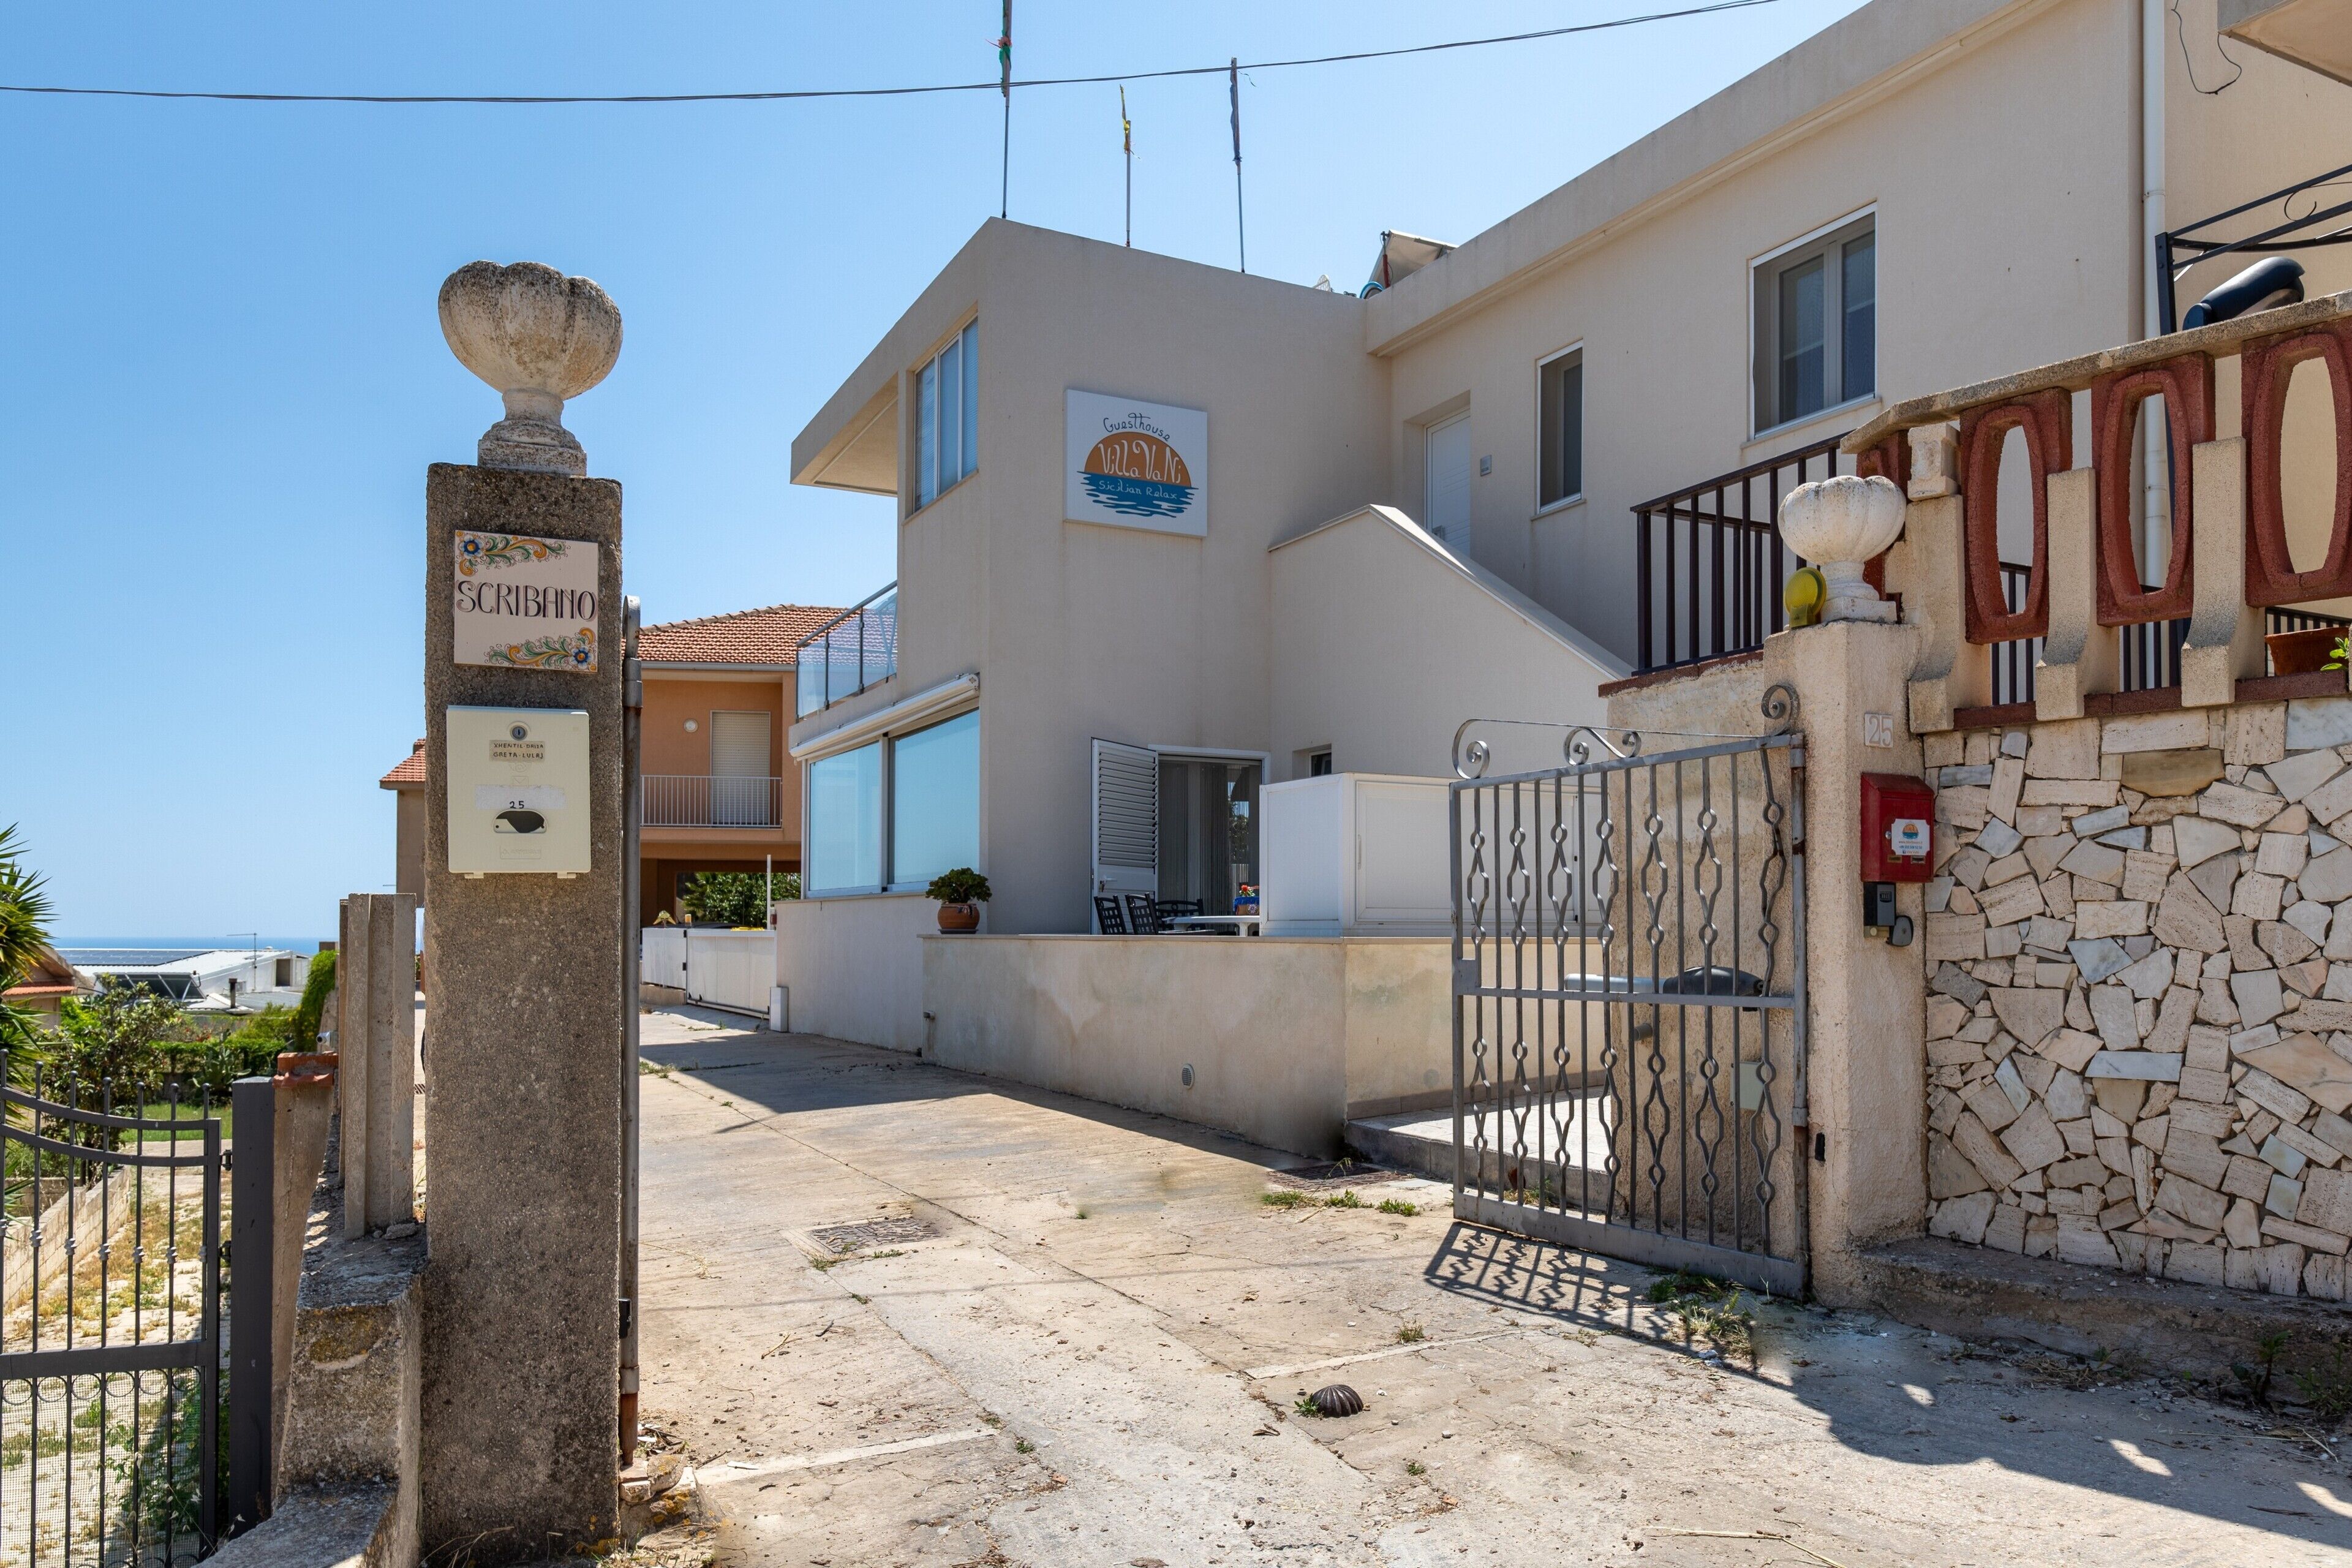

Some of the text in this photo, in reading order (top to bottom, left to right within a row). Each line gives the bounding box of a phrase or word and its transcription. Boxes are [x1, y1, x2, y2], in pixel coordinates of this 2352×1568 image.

[1103, 412, 1170, 442] Guesthouse
[1098, 440, 1141, 477] Villa
[1099, 480, 1178, 499] Sicilian Relax
[456, 580, 598, 621] SCRIBANO
[1869, 715, 1893, 747] 25
[509, 800, 525, 809] 25
